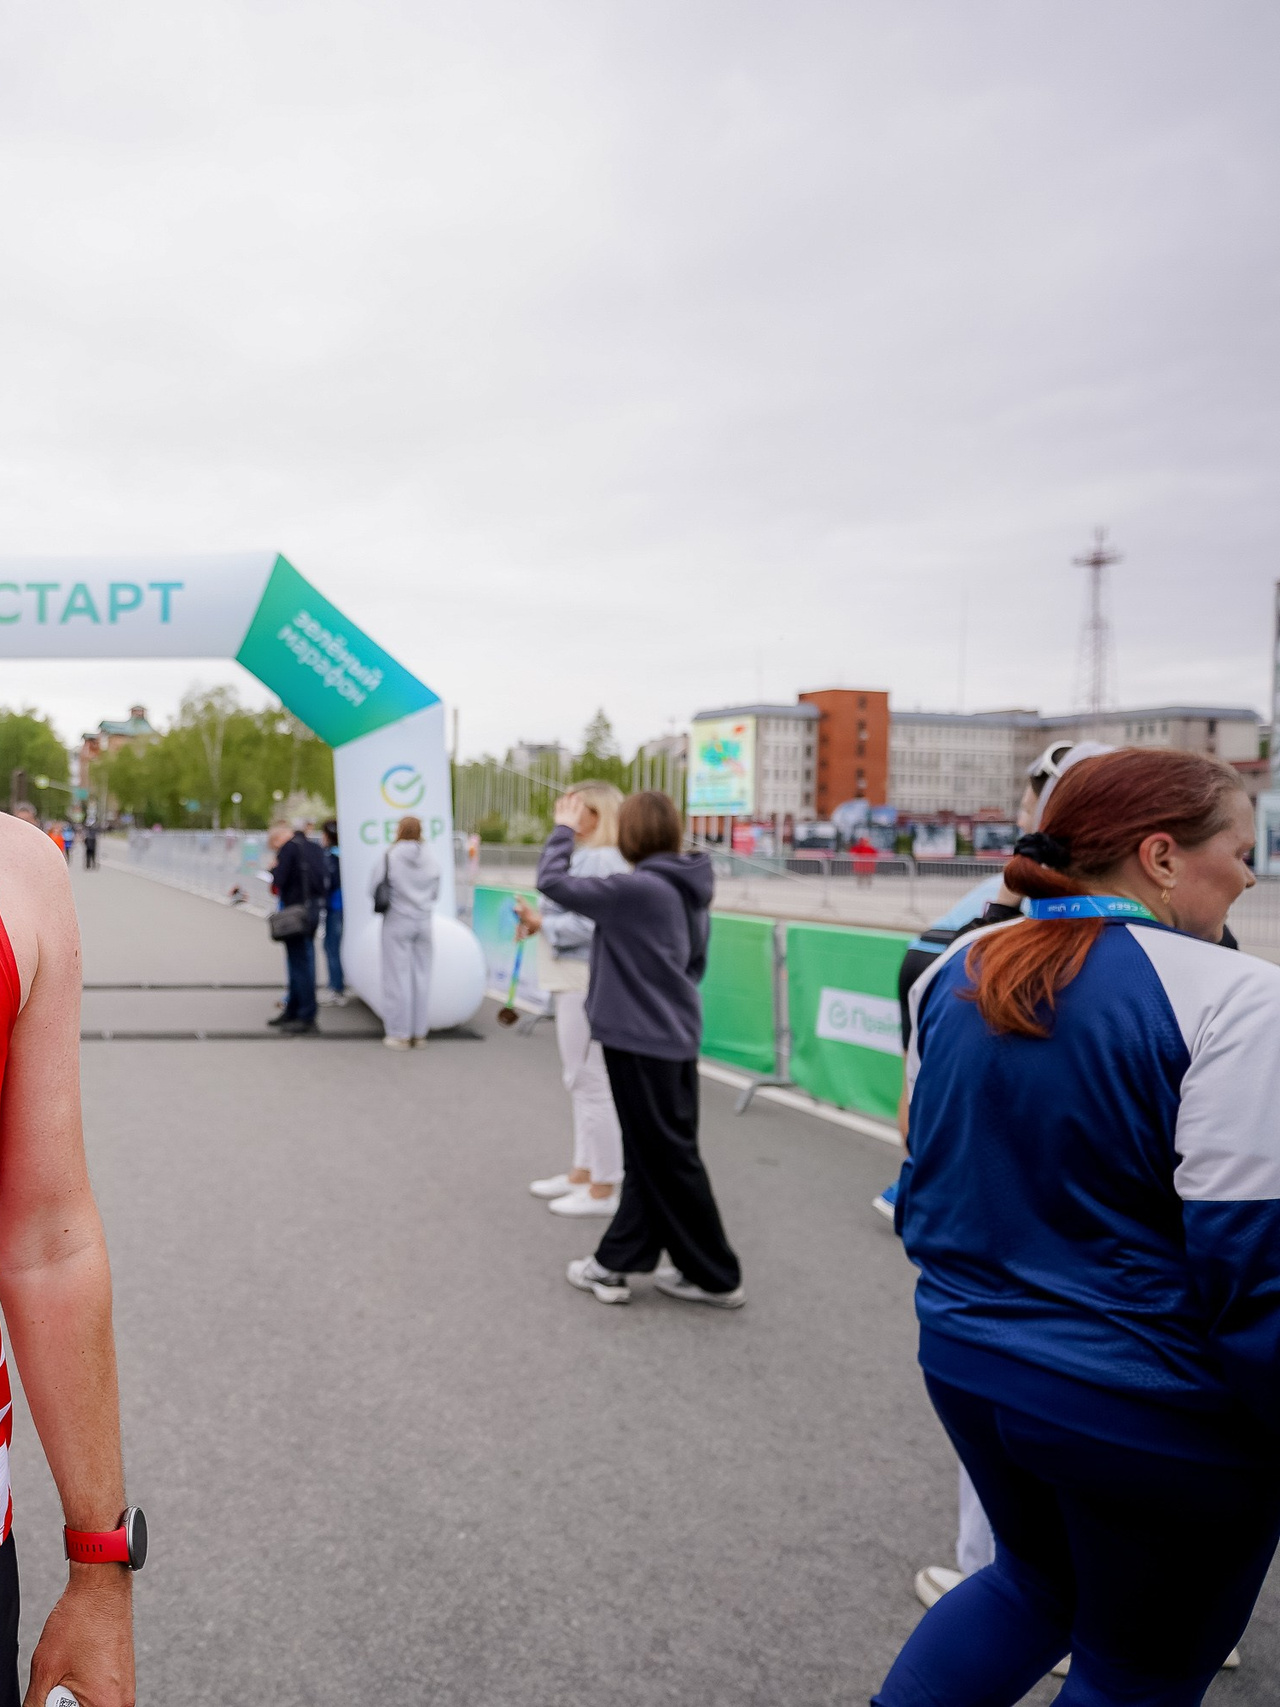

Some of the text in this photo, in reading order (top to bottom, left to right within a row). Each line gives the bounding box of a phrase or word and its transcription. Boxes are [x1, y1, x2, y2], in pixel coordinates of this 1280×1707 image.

[277, 625, 367, 707] марафон
[293, 610, 383, 691] зелёный
[359, 817, 445, 845] СБР
